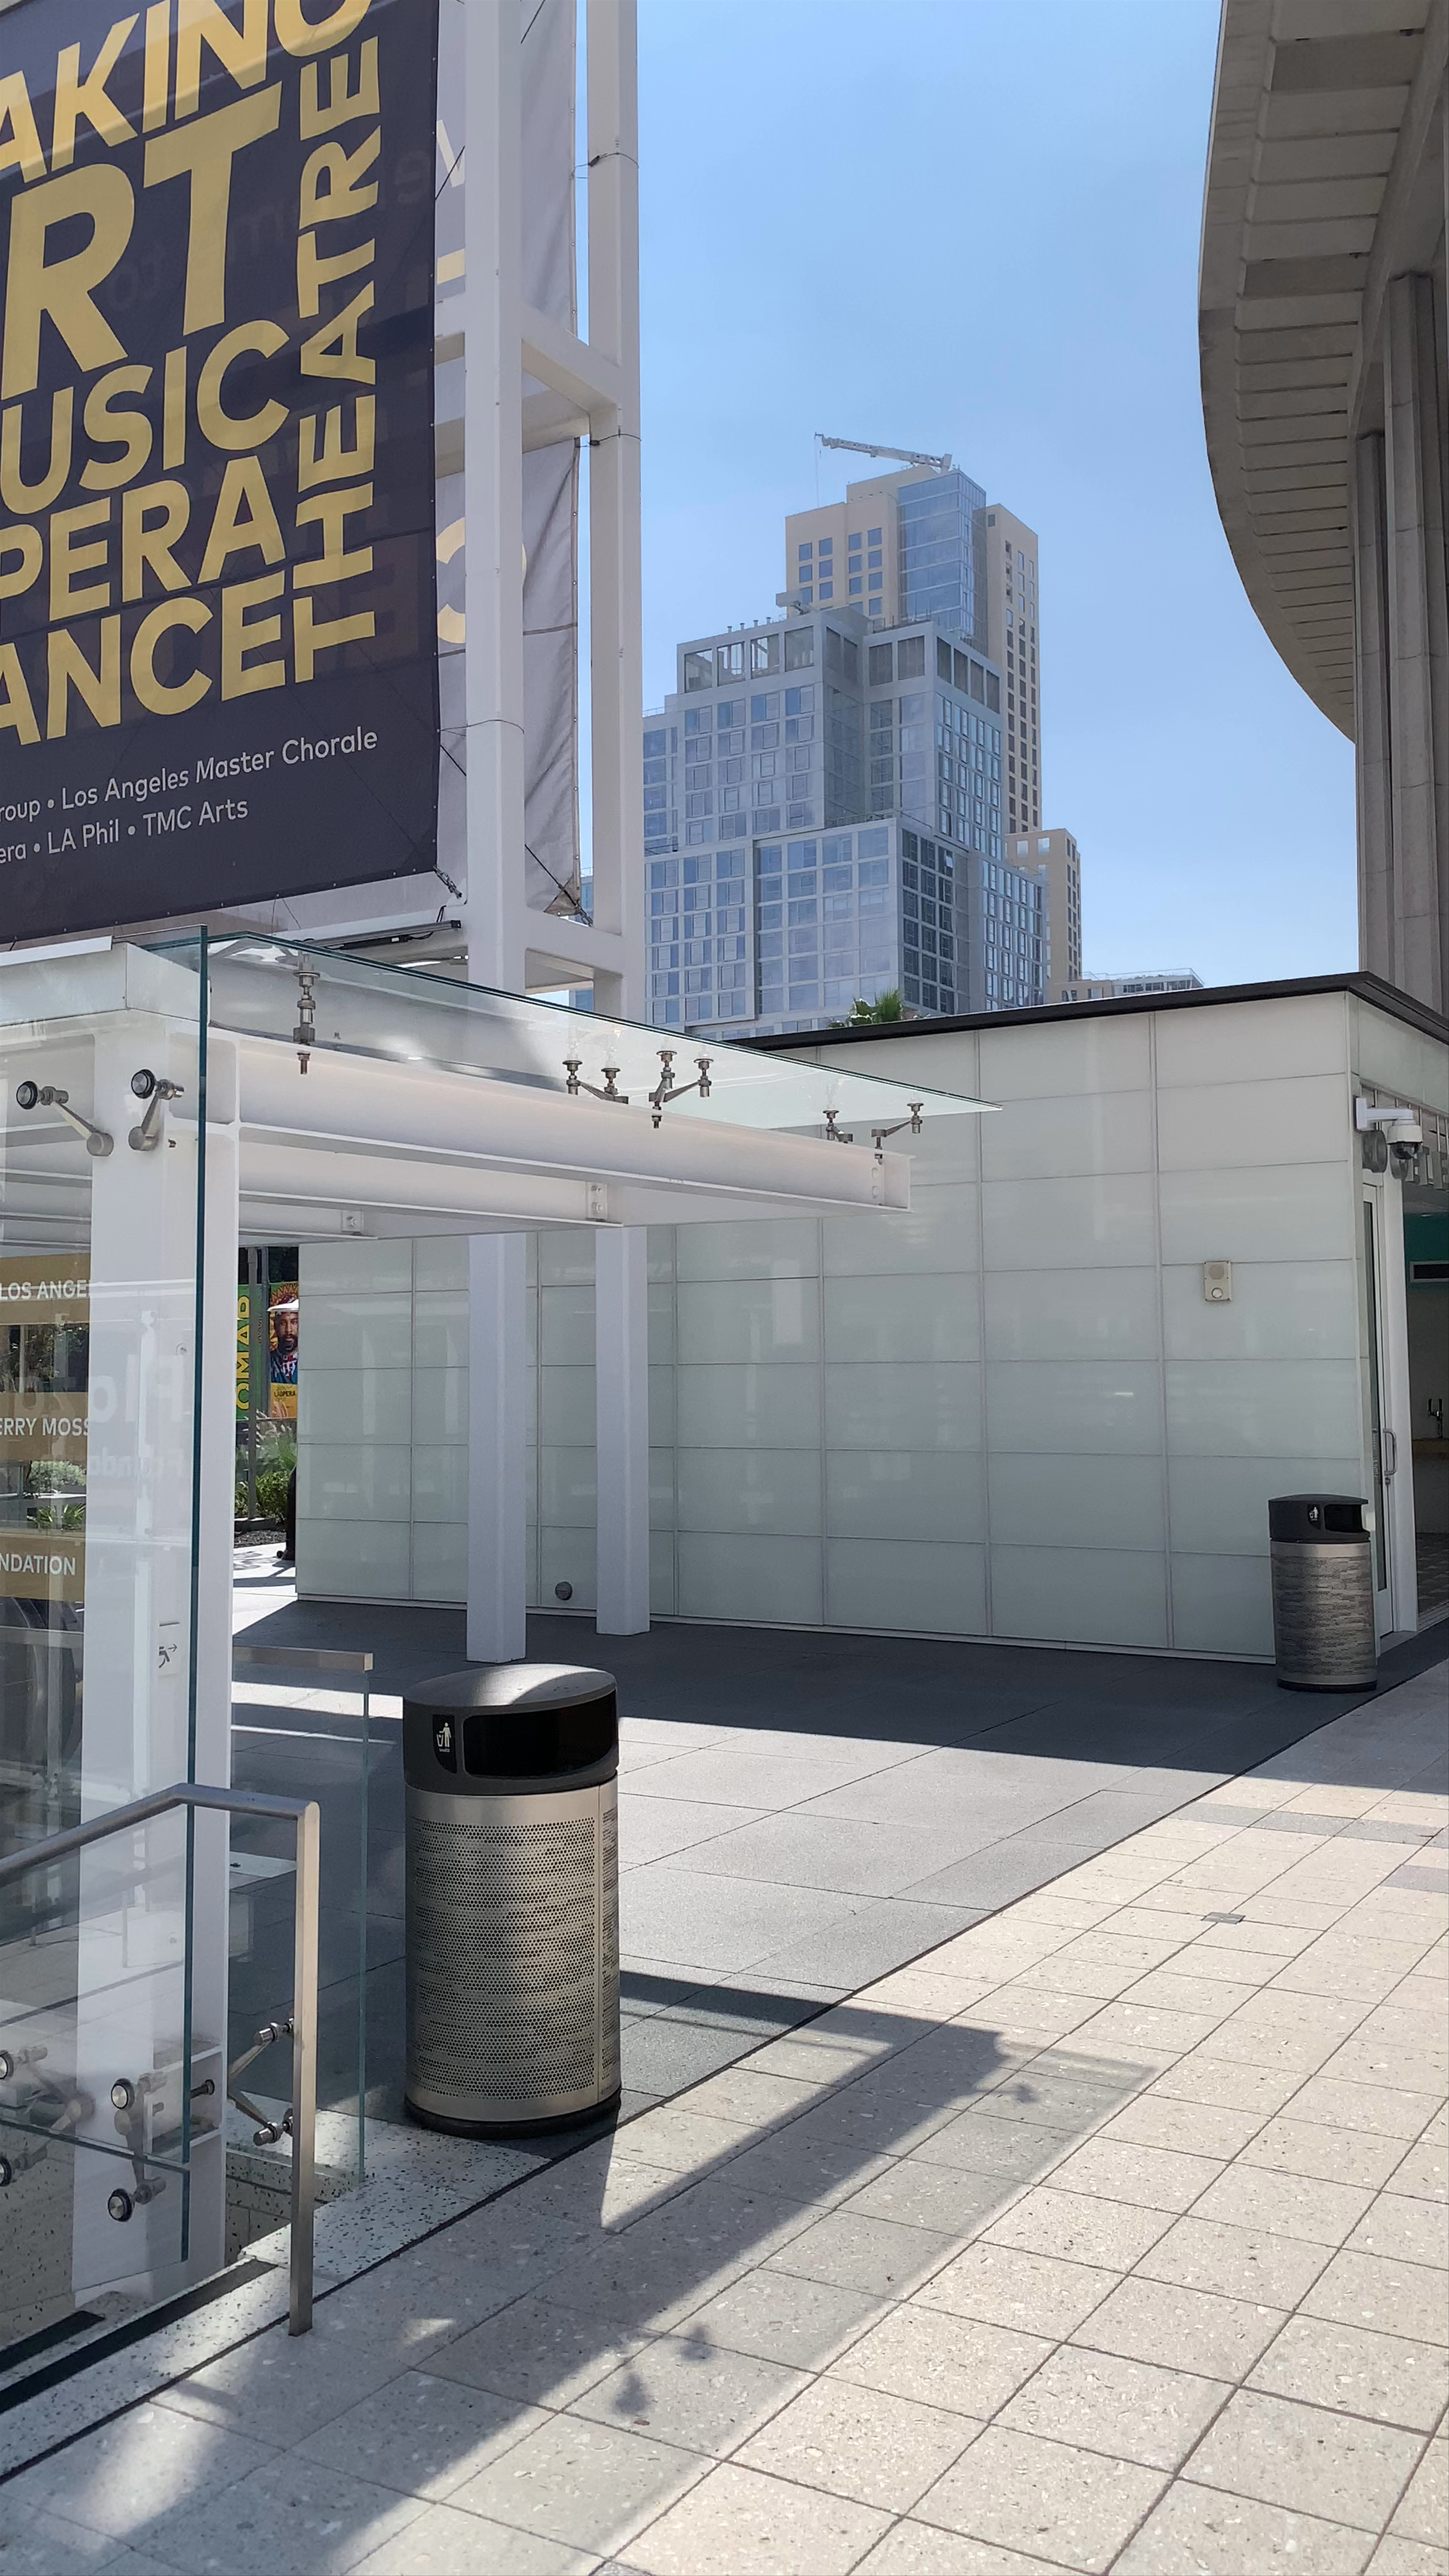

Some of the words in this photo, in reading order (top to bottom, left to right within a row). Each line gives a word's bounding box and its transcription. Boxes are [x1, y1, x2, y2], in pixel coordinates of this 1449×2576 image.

[293, 36, 381, 683] THEATRE
[0, 320, 290, 515] USIC
[62, 787, 98, 810] Los
[104, 767, 189, 802] Angeles
[195, 752, 274, 783] Master
[282, 726, 378, 764] Chorale
[48, 828, 77, 854] LA
[83, 819, 119, 847] Phil
[143, 806, 192, 837] TMC
[198, 799, 249, 826] Arts
[0, 1281, 32, 1300] LOS
